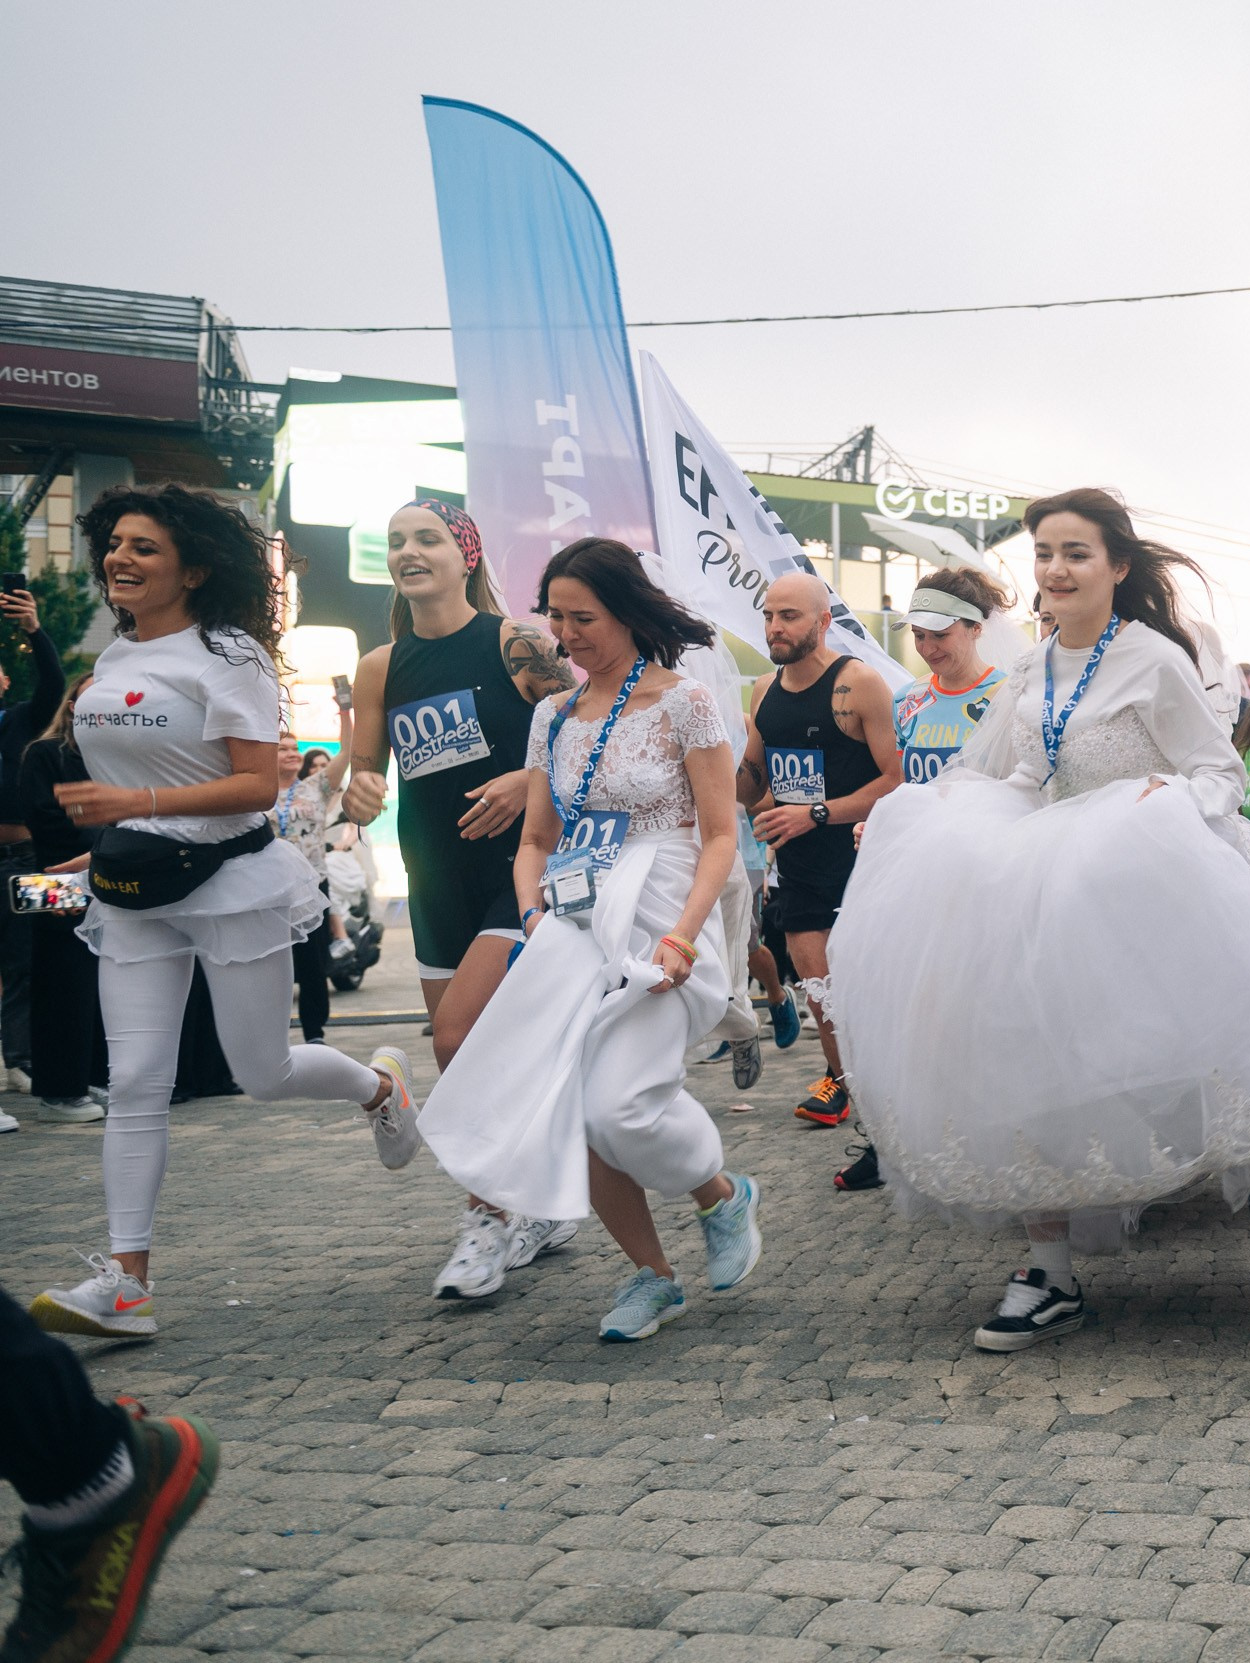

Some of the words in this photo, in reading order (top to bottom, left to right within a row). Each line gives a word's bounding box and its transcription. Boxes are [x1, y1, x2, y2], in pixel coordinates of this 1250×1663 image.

[923, 489, 1010, 520] СБЕР
[394, 698, 464, 750] 001
[914, 723, 960, 748] RUN
[400, 716, 479, 774] Gastreet
[771, 752, 815, 781] 001
[771, 772, 823, 795] Gastreet
[119, 881, 140, 894] EAT
